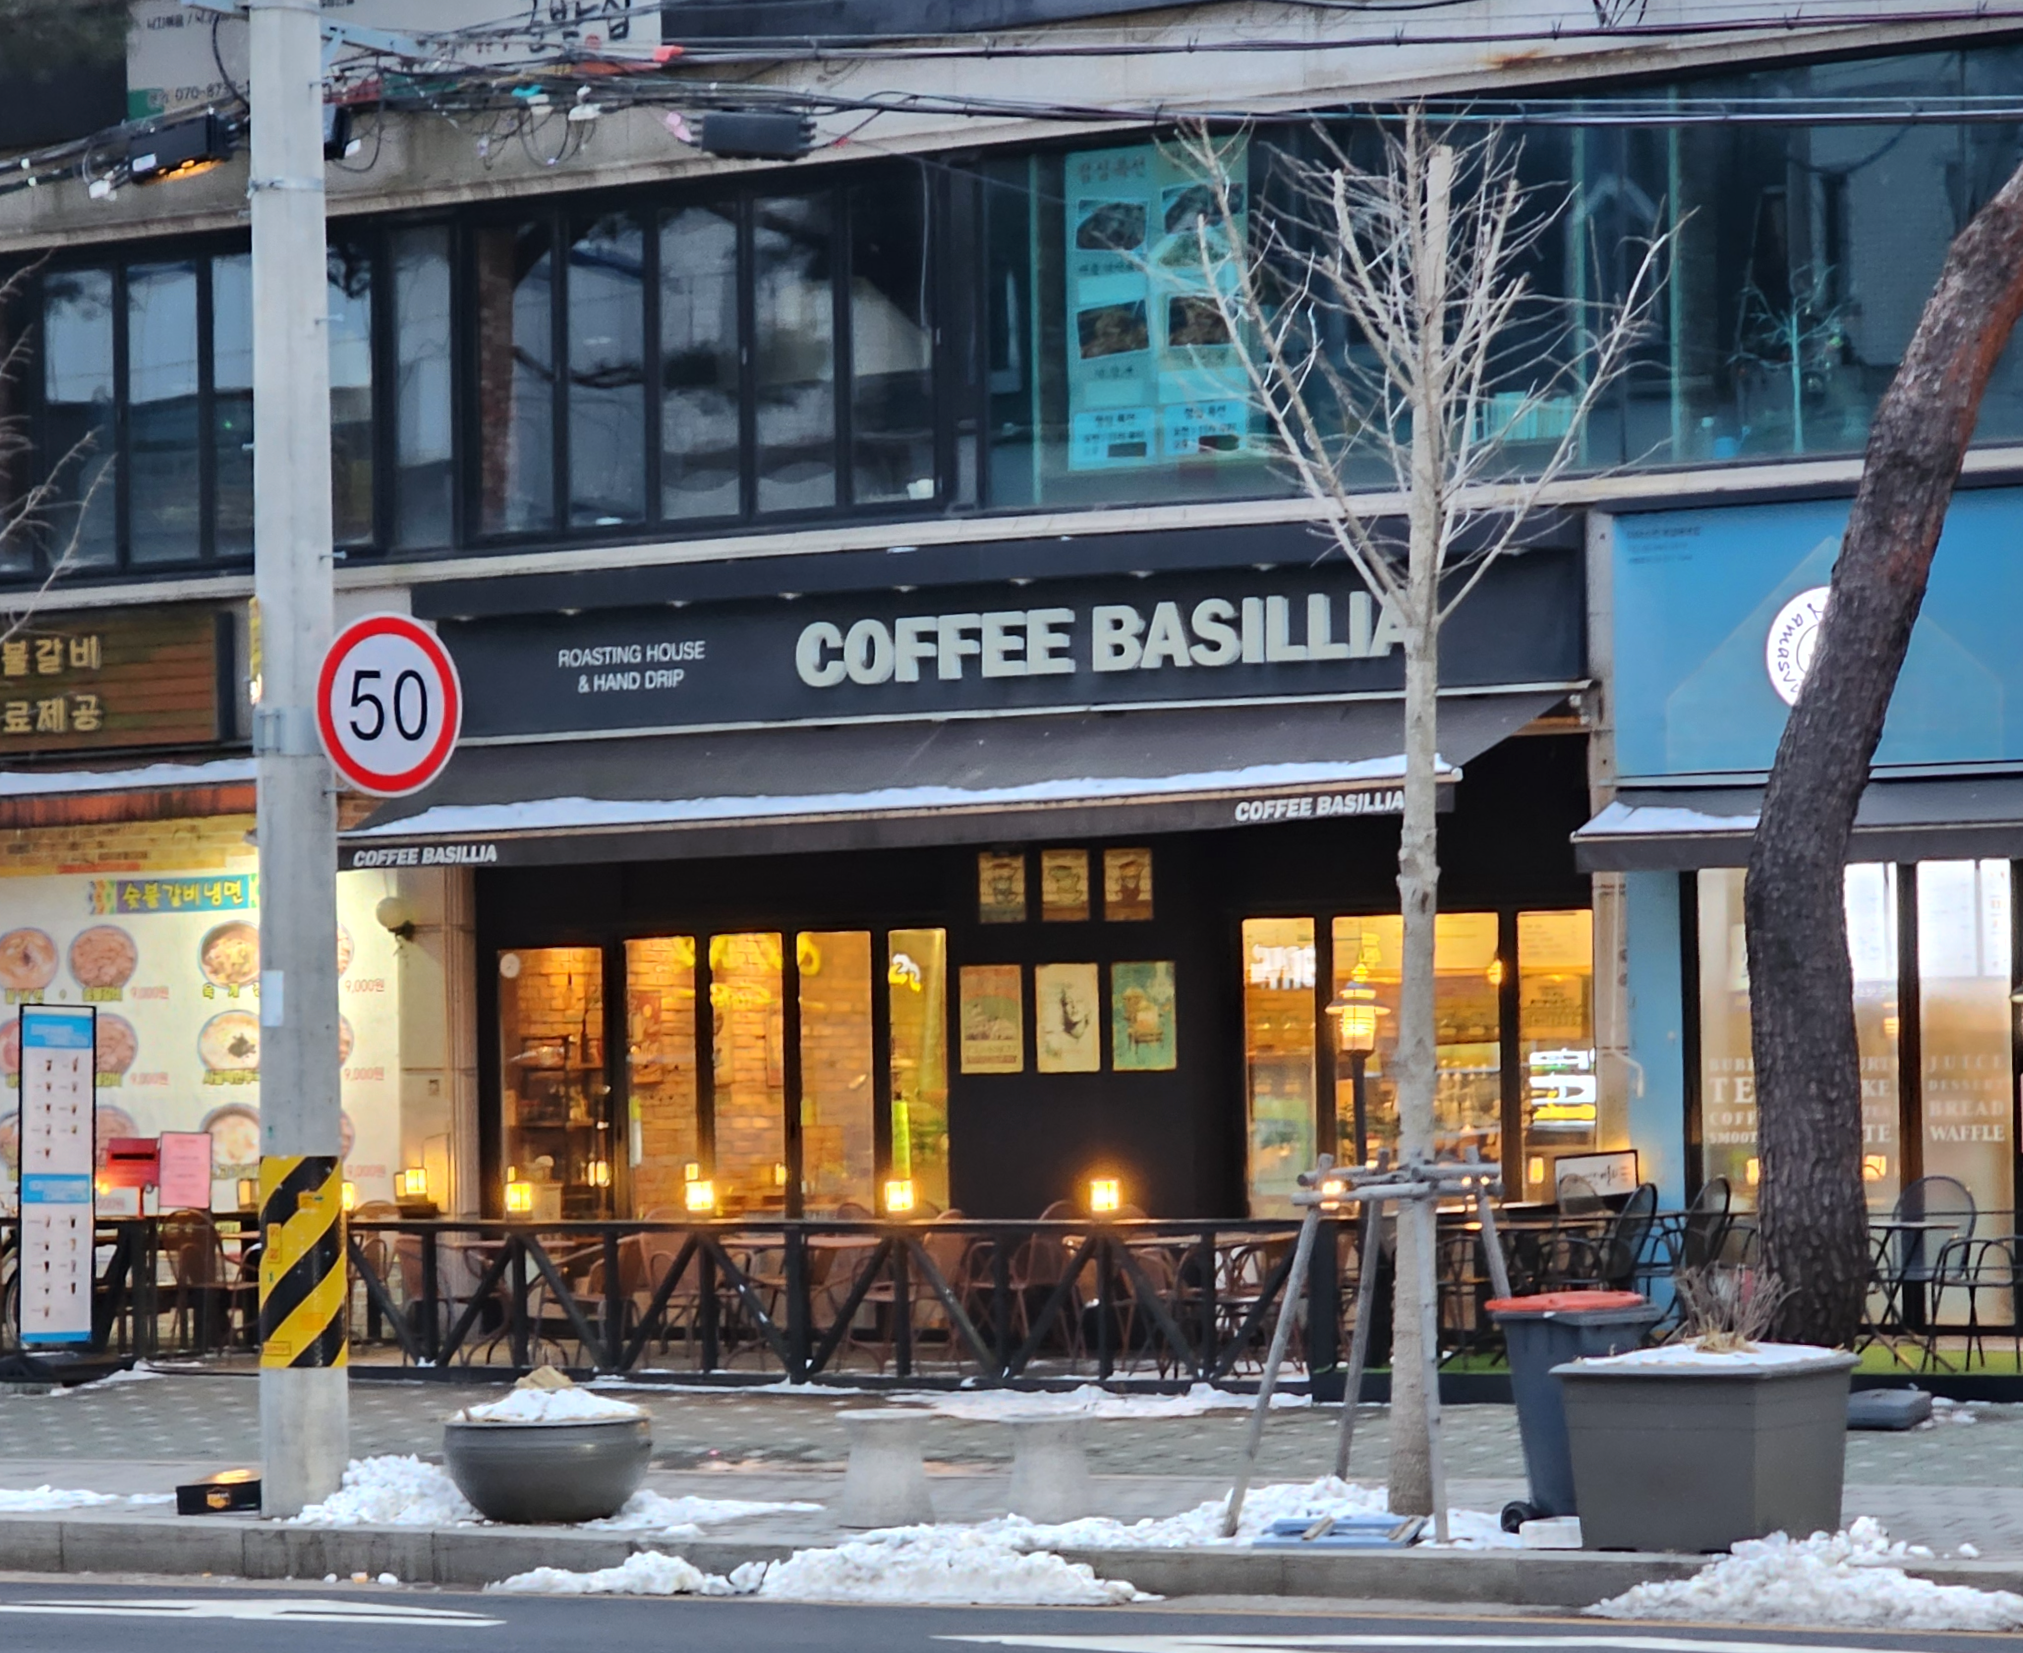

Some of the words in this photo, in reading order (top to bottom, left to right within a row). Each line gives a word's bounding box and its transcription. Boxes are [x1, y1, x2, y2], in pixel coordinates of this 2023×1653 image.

[796, 607, 1076, 687] COFFEE
[1093, 588, 1407, 671] BASILLIA
[2, 635, 101, 676] 불갈비
[558, 644, 642, 668] ROASTING
[646, 640, 706, 663] HOUSE
[578, 674, 590, 693] &
[593, 671, 641, 692] HAND
[644, 668, 684, 689] DRIP
[3, 695, 101, 733] 료제공
[350, 669, 428, 741] 50
[1235, 797, 1313, 821] COFFEE
[1316, 790, 1405, 815] BASILLIA
[353, 847, 418, 867] COFFEE
[421, 844, 497, 864] BASILLIA
[1928, 1054, 2004, 1073] JUICE
[1929, 1100, 2004, 1118] BREAD
[1929, 1124, 2005, 1142] WAFFLE
